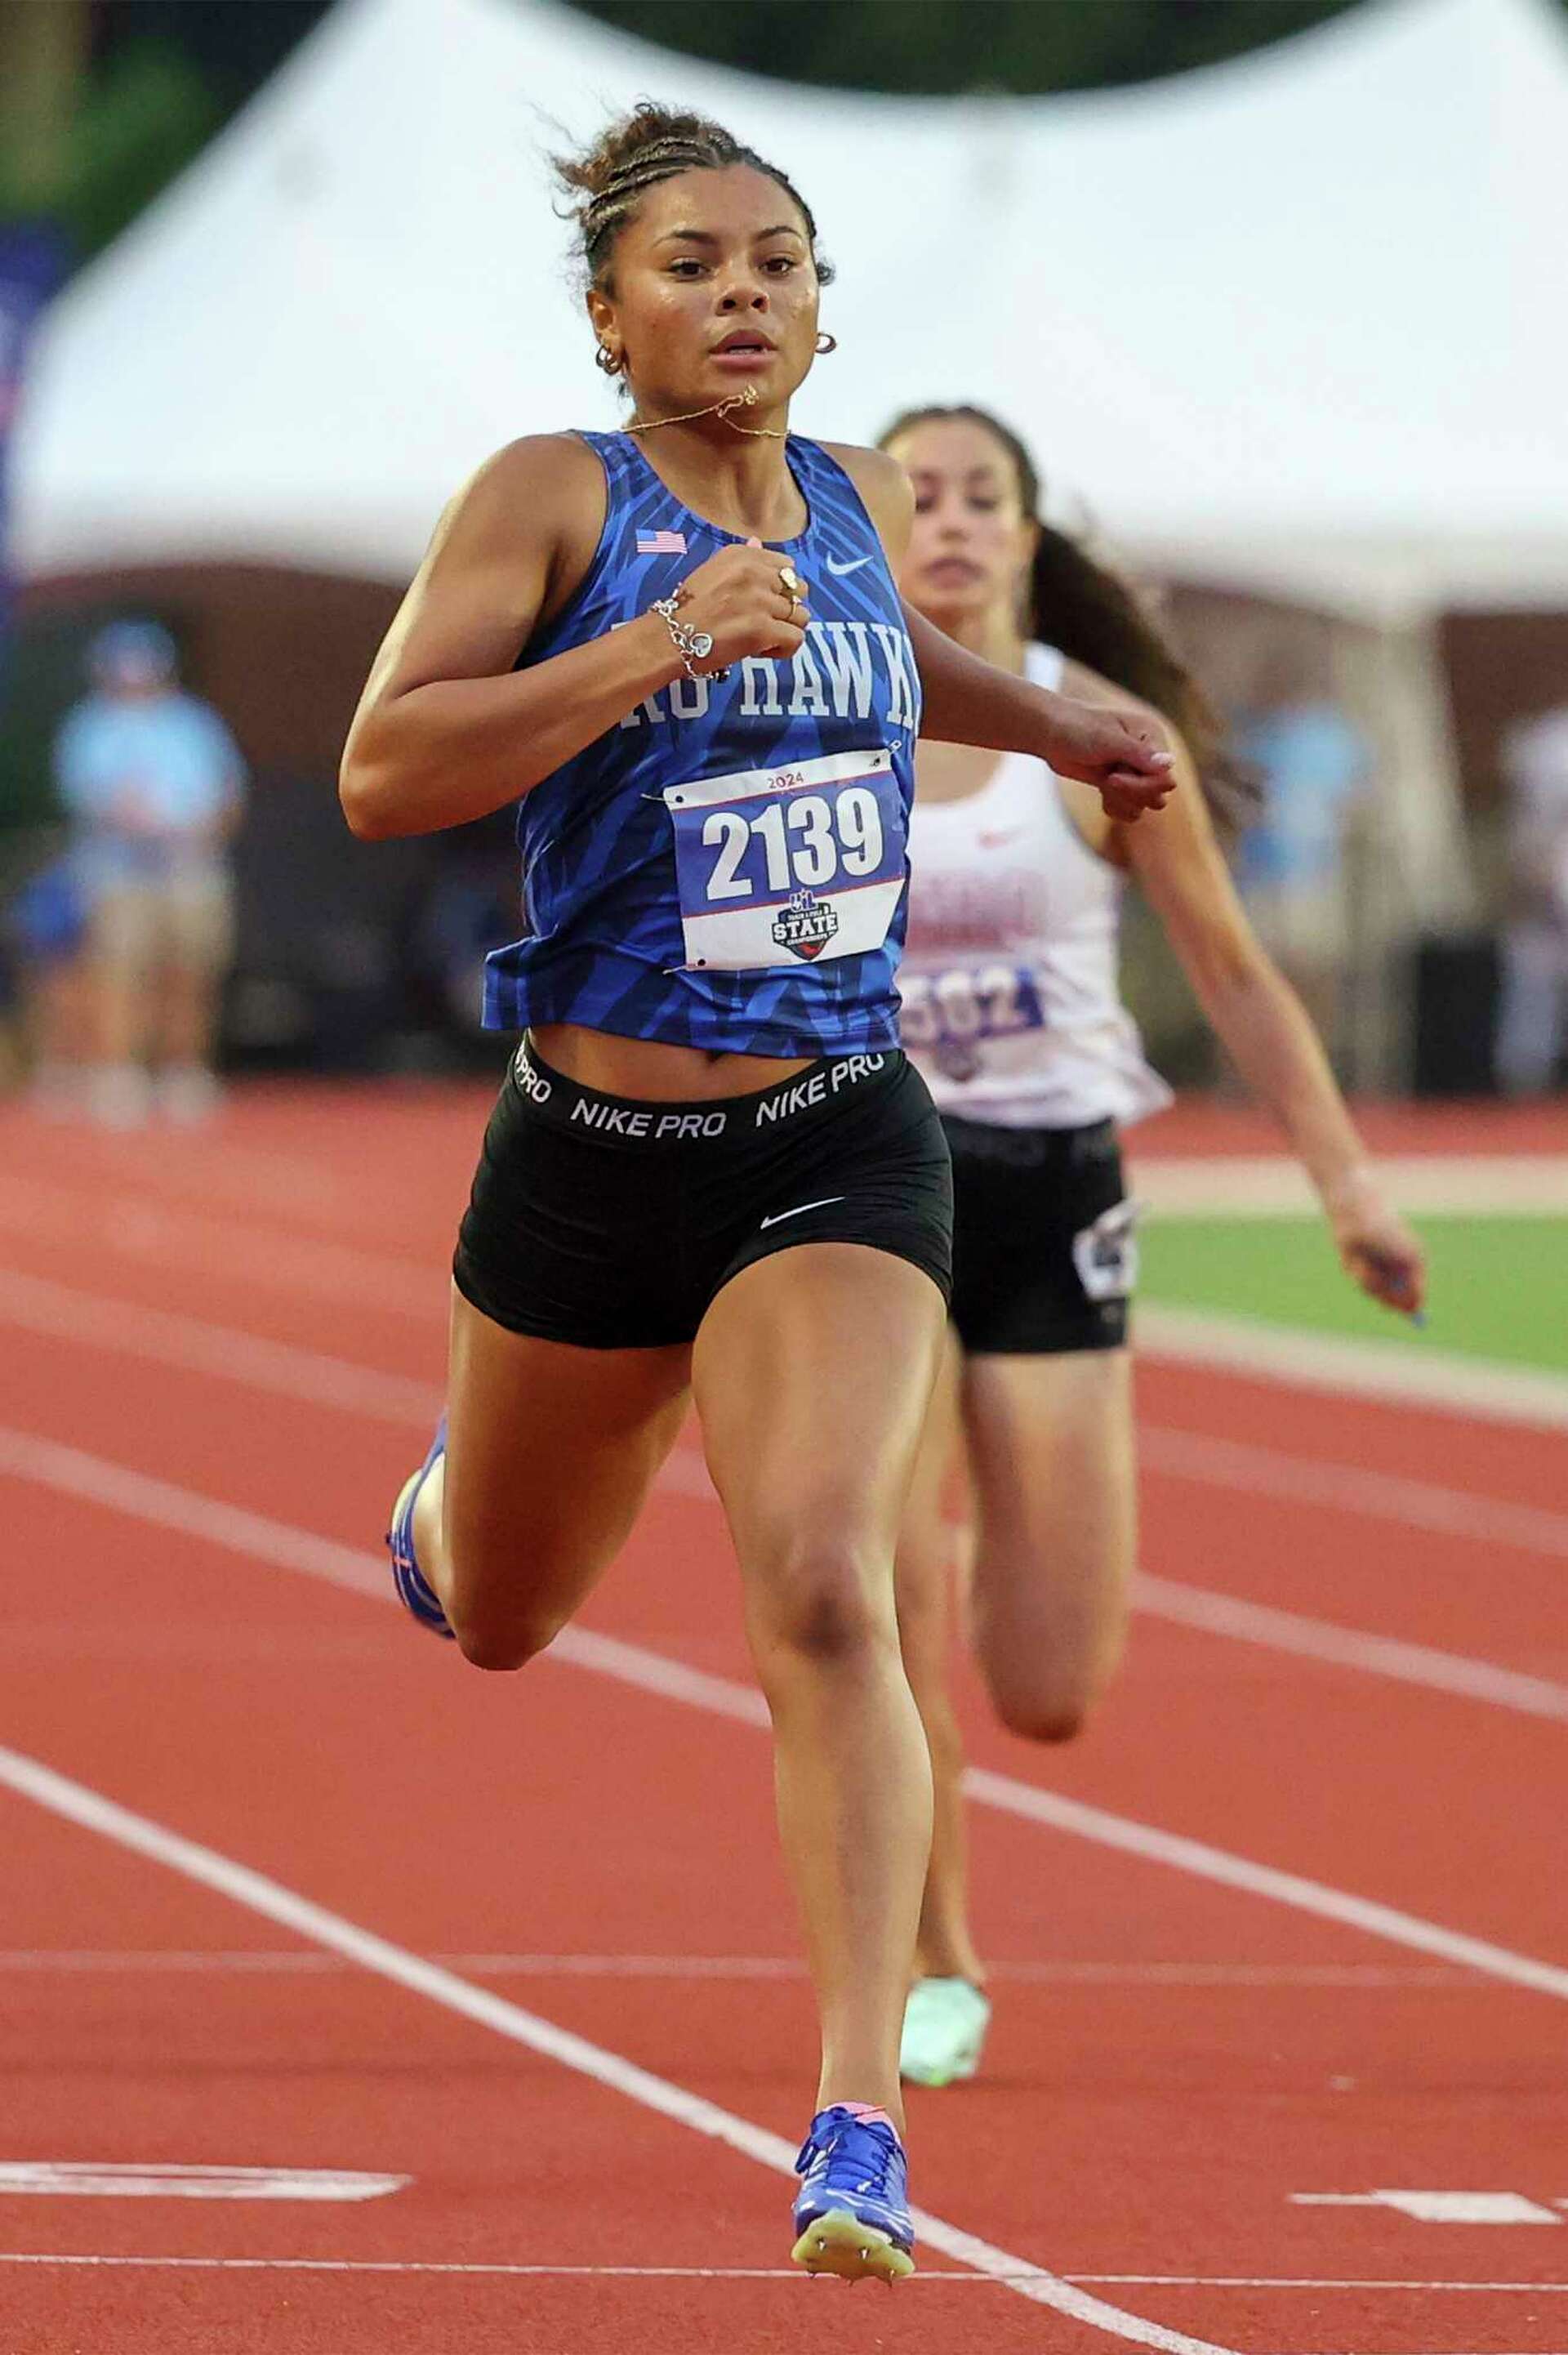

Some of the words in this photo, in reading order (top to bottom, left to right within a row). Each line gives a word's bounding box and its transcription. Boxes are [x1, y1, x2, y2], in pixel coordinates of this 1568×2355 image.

[768, 772, 804, 790] 2024
[702, 787, 884, 901] 2139
[773, 913, 838, 941] STATE
[570, 1098, 653, 1137] NIKE
[655, 1112, 728, 1140] PRO
[755, 1072, 827, 1128] NIKE
